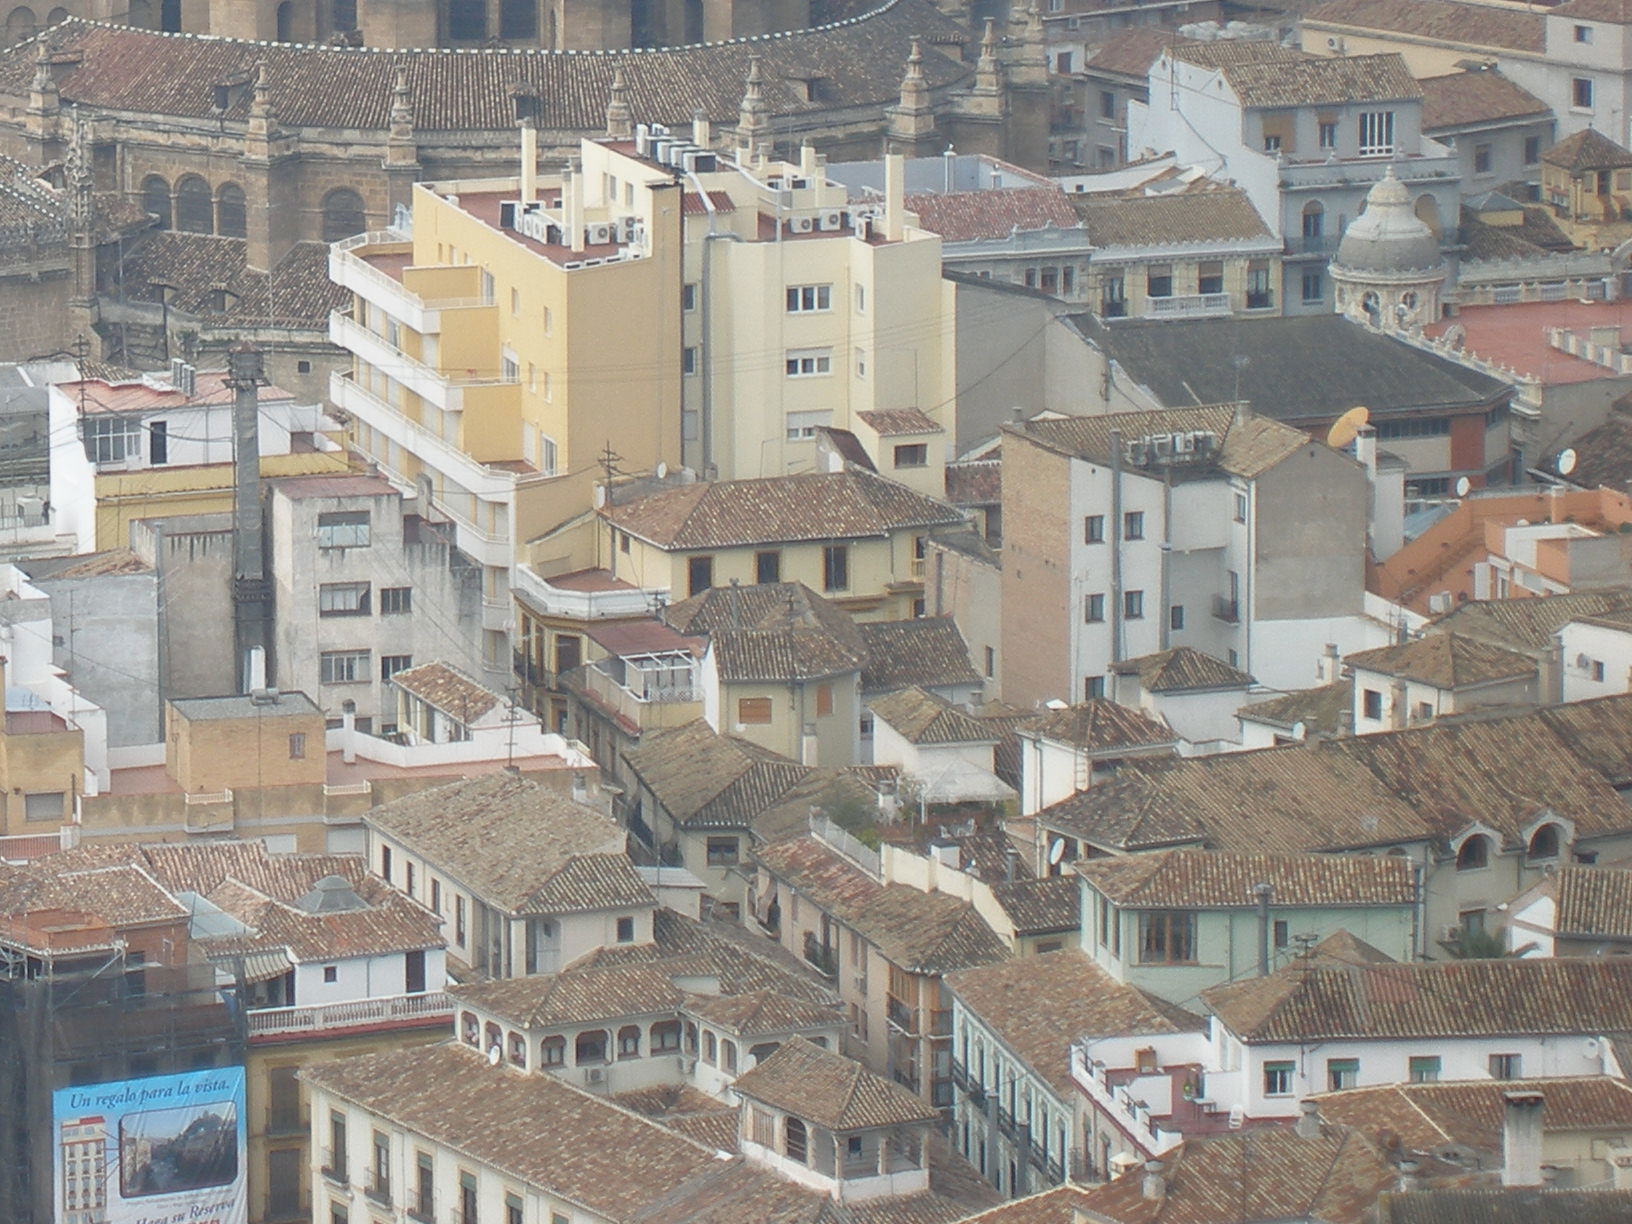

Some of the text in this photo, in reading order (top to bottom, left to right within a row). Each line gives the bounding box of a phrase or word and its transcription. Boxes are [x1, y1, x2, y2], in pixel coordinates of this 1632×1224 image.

[70, 1079, 230, 1109] Un regalo para la vista.
[171, 1213, 185, 1223] su
[189, 1198, 235, 1219] Reserva
